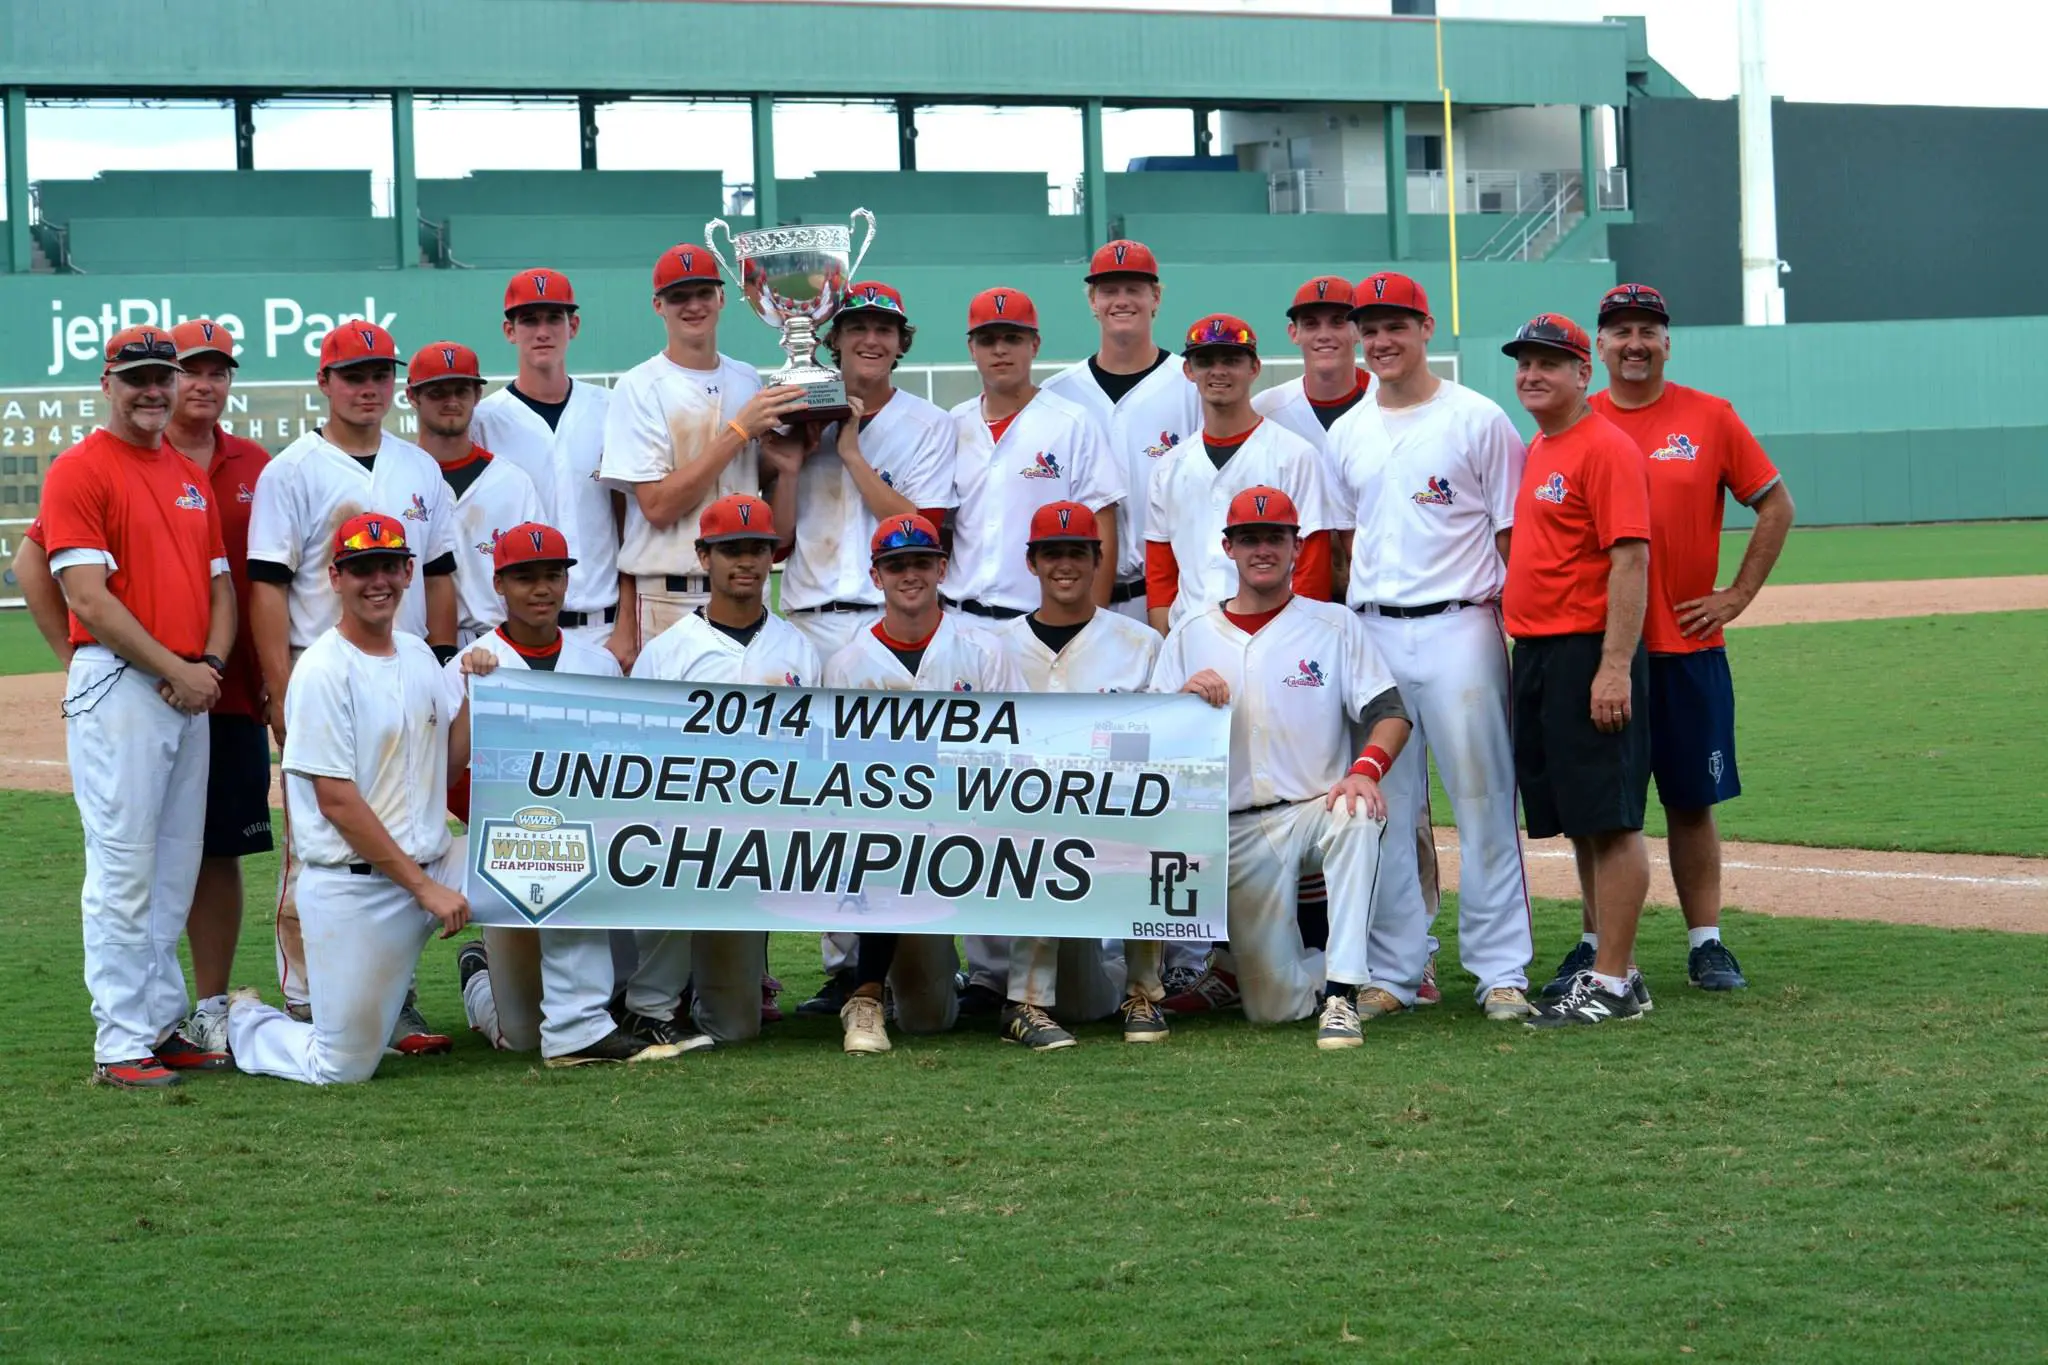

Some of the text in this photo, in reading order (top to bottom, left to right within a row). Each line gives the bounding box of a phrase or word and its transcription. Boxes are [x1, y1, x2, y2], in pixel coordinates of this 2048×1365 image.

[48, 298, 245, 375] jetle
[683, 689, 1019, 745] 2014 WWBA
[528, 752, 1170, 817] UNDERCLASS WORLD
[519, 813, 558, 826] WWBA
[497, 831, 580, 840] UNDERCLASS
[492, 838, 586, 862] WORLD
[490, 860, 585, 873] CHAMPIONSHIP
[608, 824, 1095, 901] CHAMPIONS
[1133, 922, 1216, 938] BASEBALL
